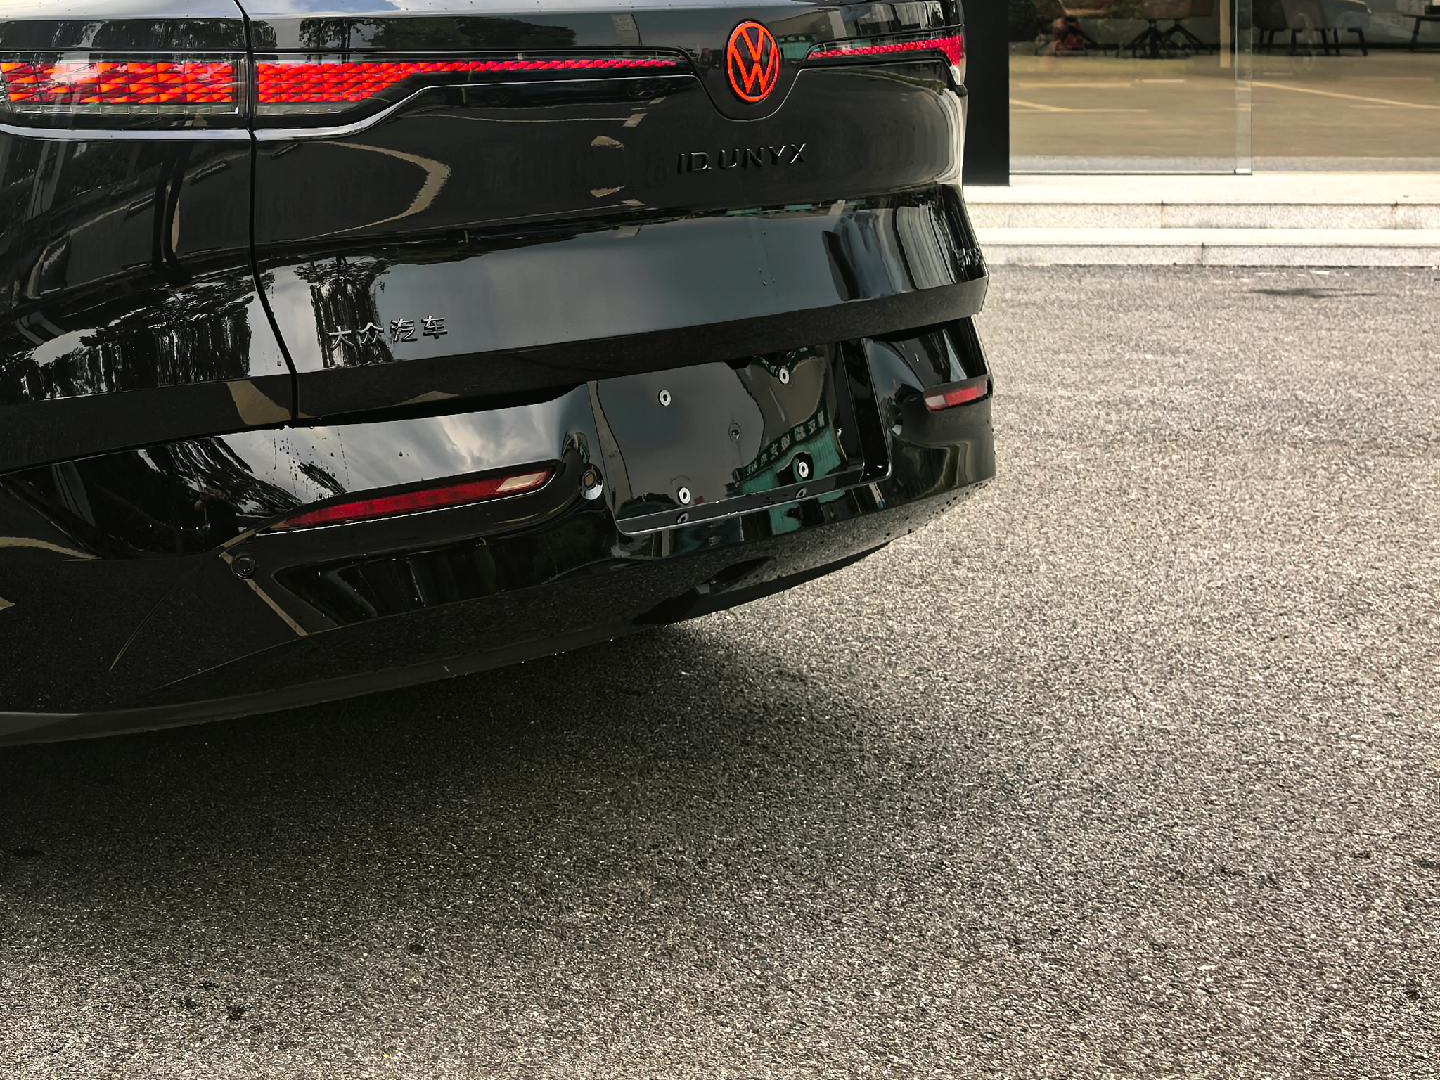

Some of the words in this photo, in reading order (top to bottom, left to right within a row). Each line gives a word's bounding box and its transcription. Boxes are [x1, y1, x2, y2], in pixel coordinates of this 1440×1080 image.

[727, 21, 780, 102] VW
[677, 142, 806, 174] ID.UNYX
[327, 315, 448, 349] 大众汽车
